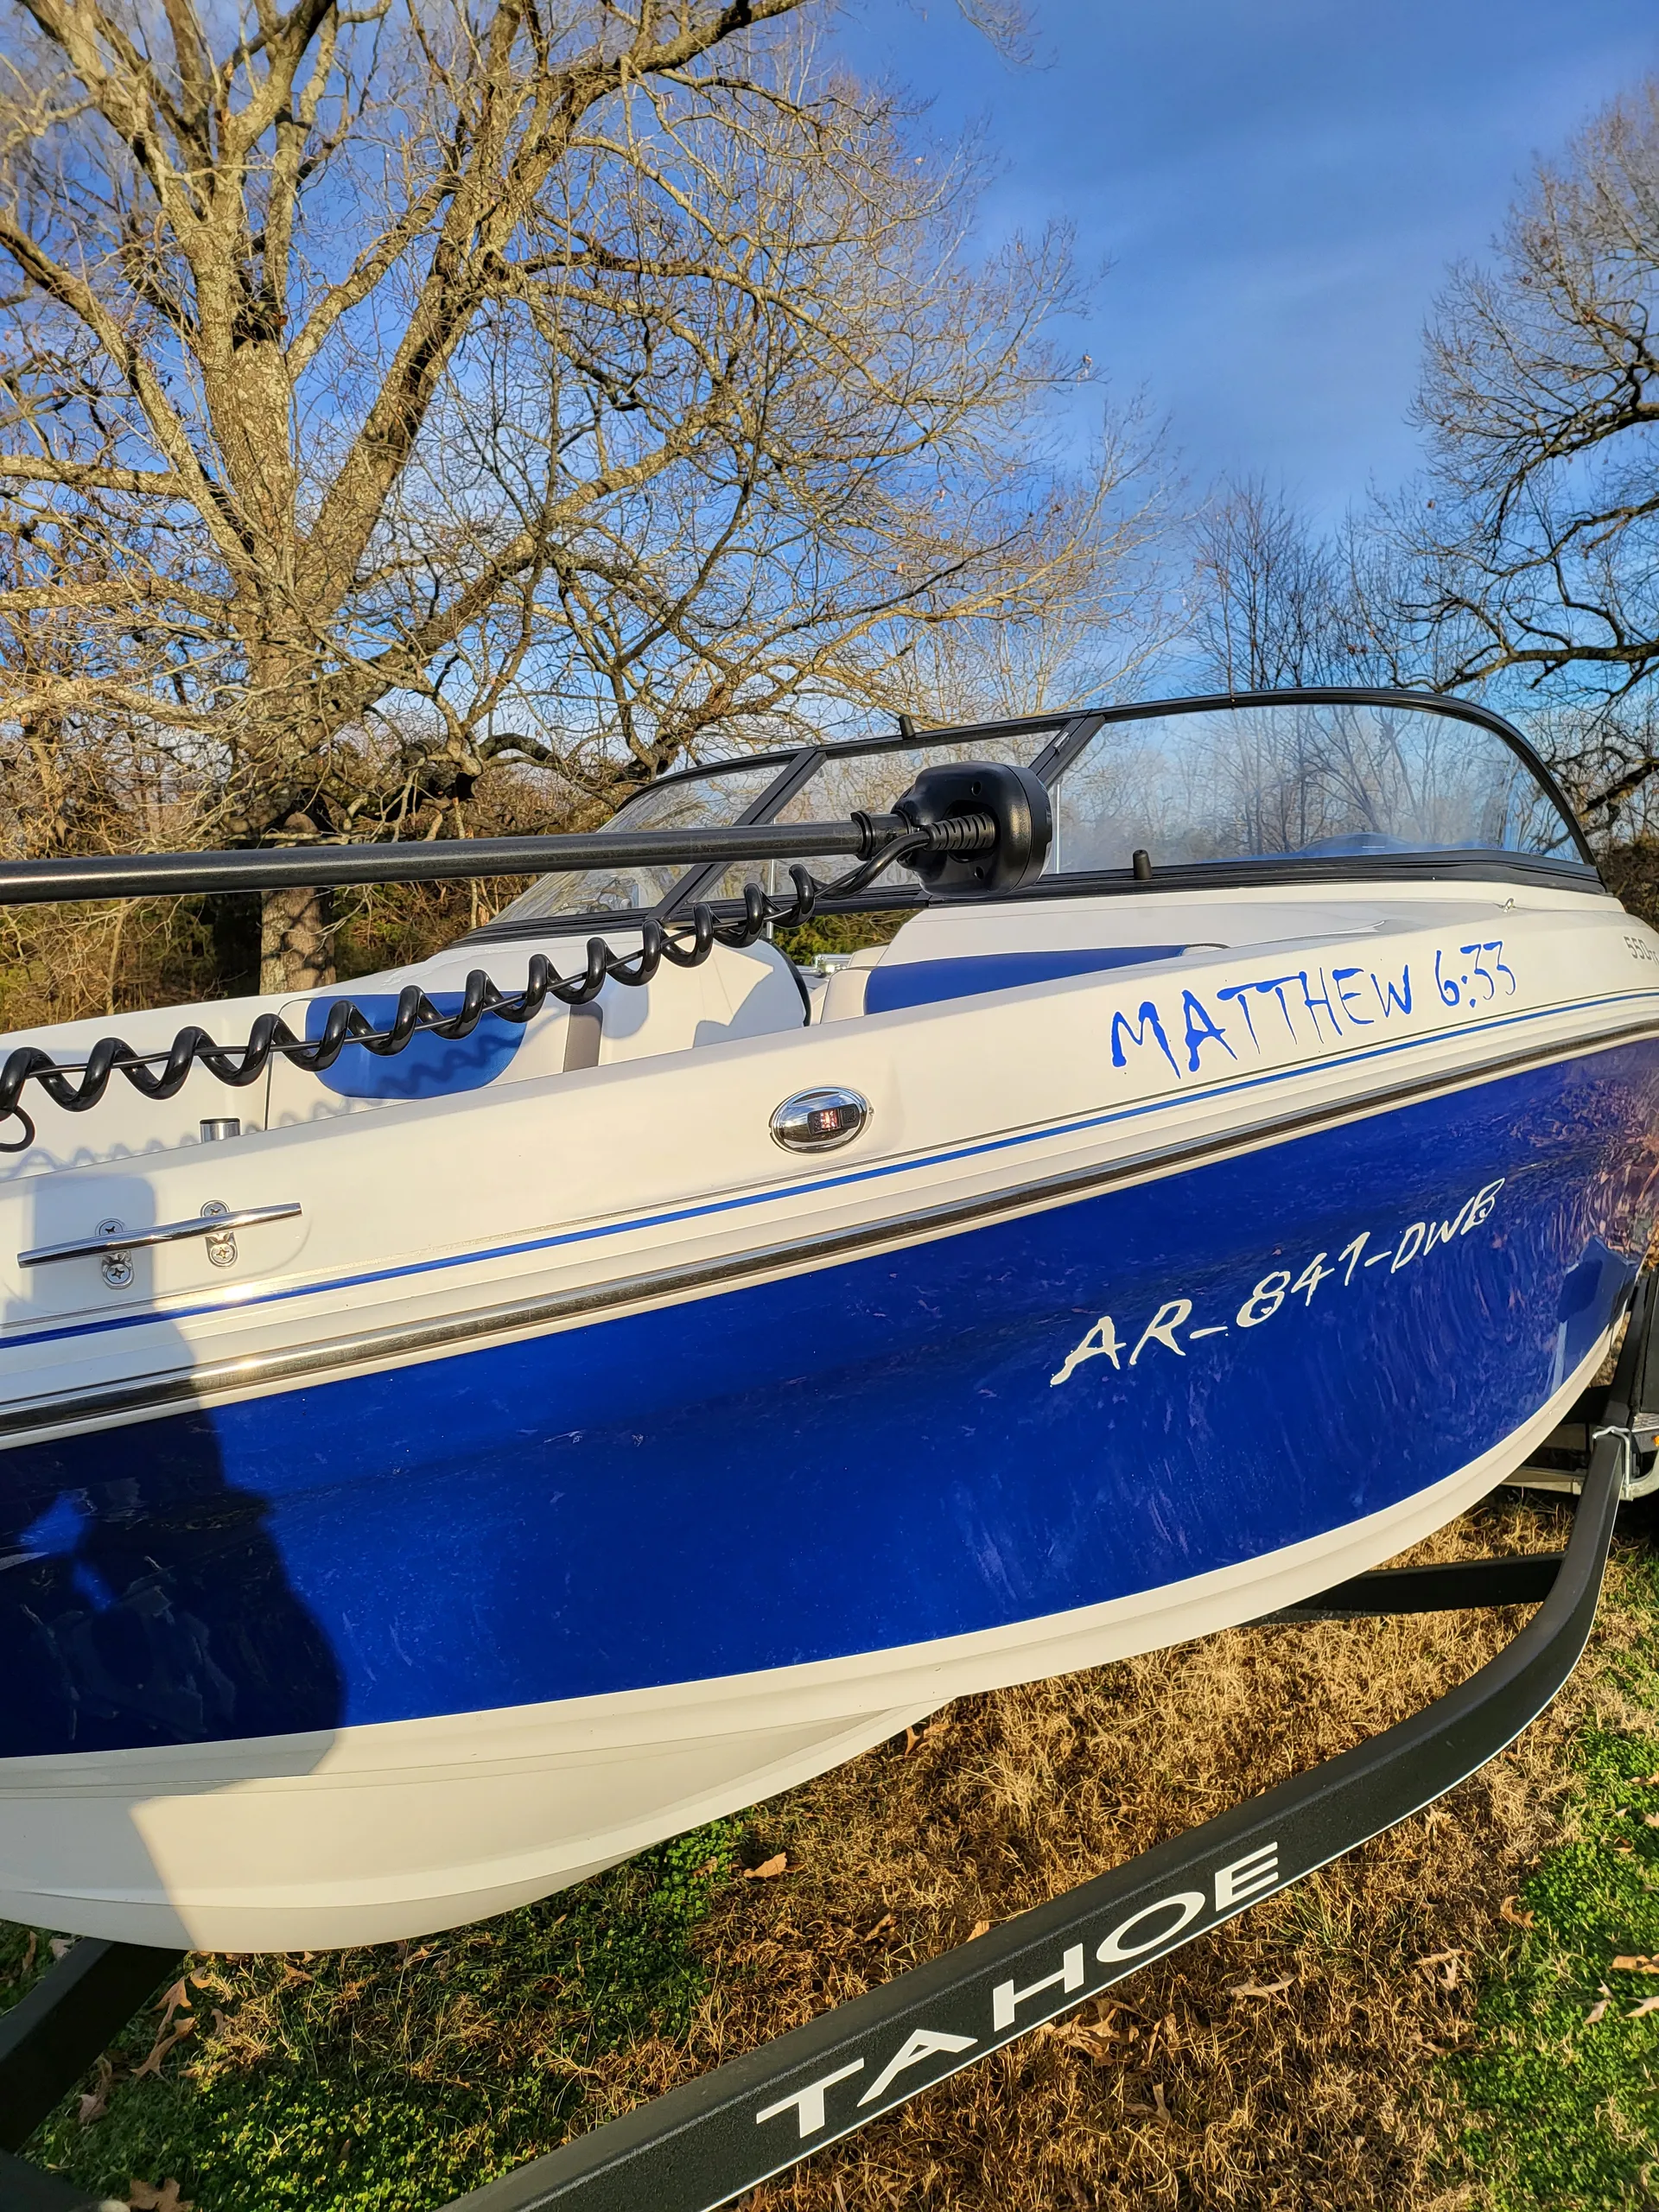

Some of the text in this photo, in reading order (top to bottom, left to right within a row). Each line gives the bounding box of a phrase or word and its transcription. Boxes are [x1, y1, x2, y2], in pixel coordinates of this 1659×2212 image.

[1110, 940, 1516, 1080] MATTHEW 6:33
[755, 1841, 1279, 2139] TAHOE
